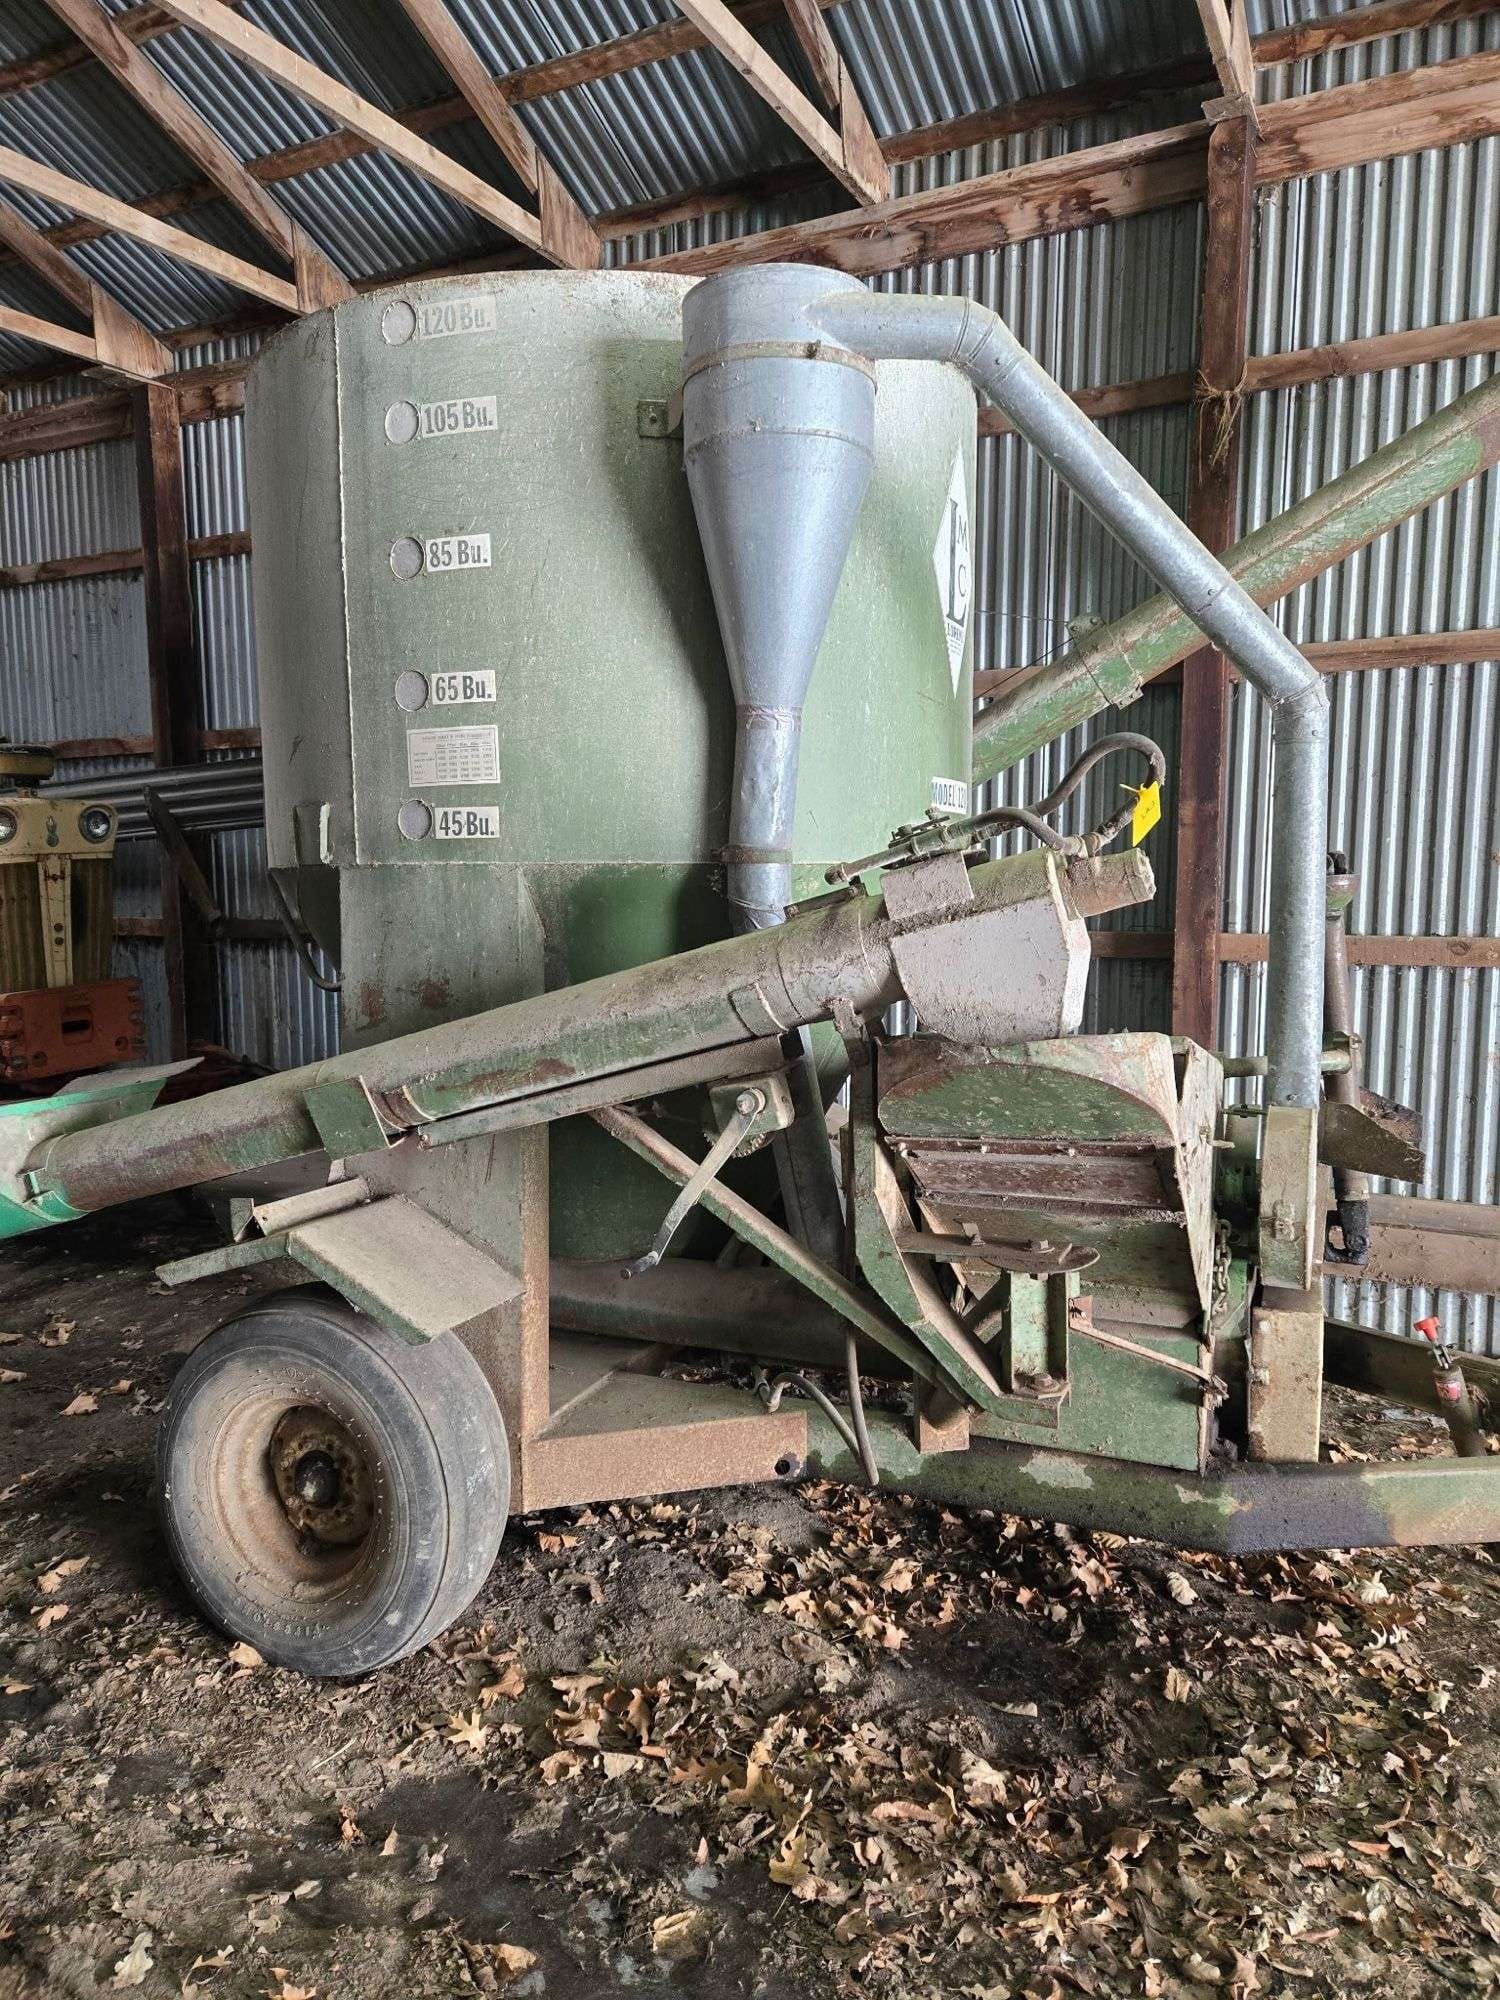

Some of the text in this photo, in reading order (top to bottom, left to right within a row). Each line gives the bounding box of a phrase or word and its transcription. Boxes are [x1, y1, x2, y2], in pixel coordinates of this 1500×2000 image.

[422, 302, 492, 336] 120 Bu.
[424, 400, 494, 435] 105 Bu.
[429, 539, 489, 568] 85 Bu.
[435, 674, 493, 702] 65 Bu.
[930, 782, 956, 807] MODEL
[439, 810, 495, 837] 45 Bu.
